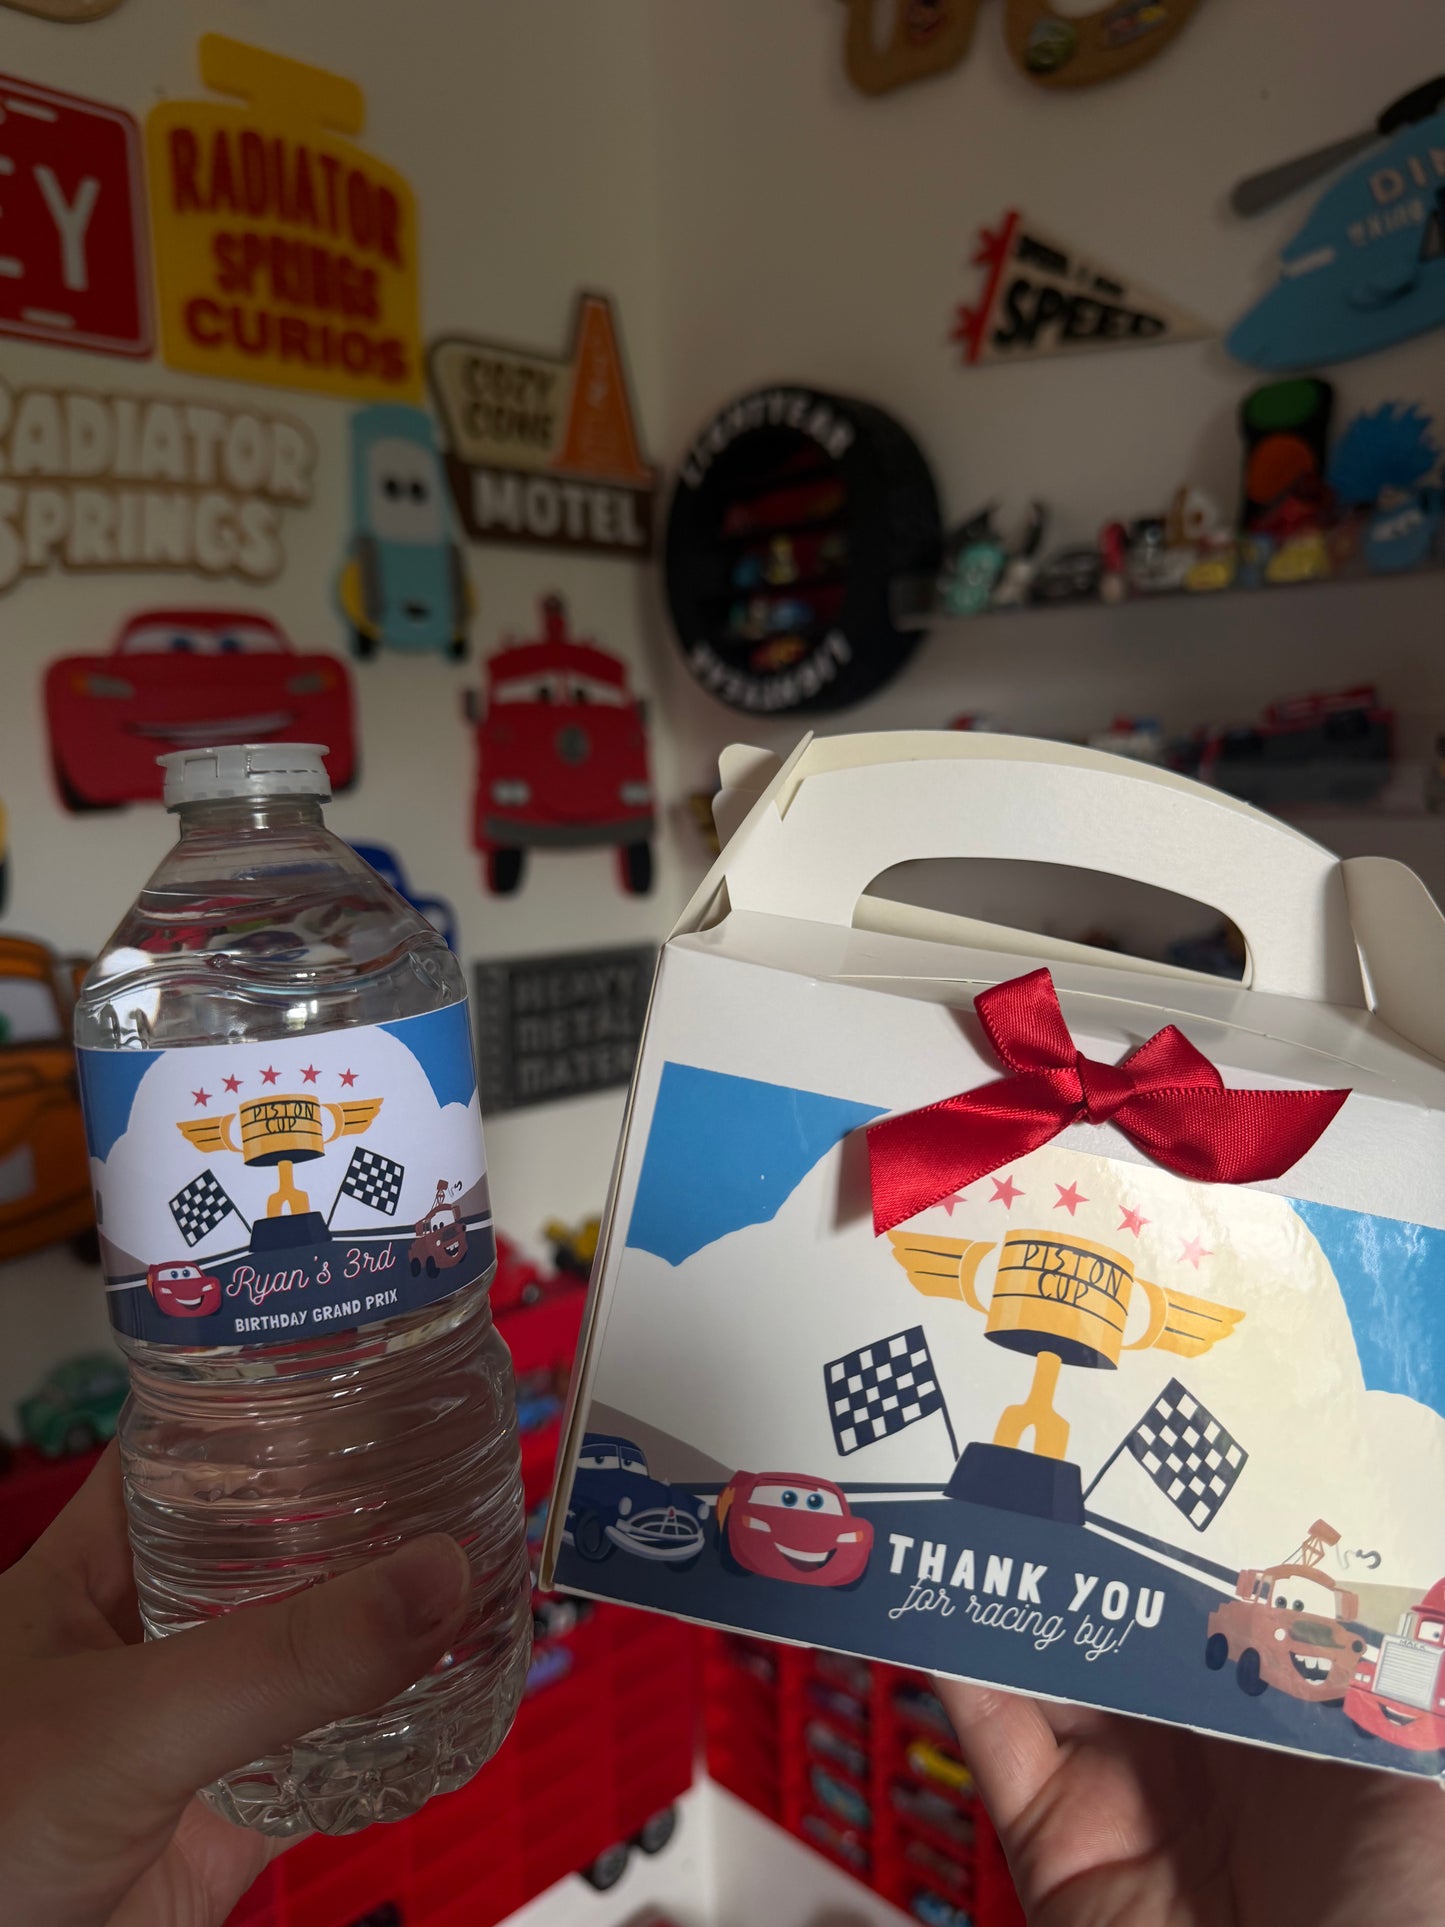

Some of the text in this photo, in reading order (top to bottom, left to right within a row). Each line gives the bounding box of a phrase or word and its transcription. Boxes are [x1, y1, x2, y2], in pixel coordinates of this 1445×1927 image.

[169, 128, 403, 268] RADIATOR
[212, 231, 380, 322] SPRINGS
[184, 297, 409, 384] CURIOS
[471, 470, 646, 545] MOTEL
[253, 1102, 314, 1121] PISTON
[265, 1117, 297, 1134] CUP
[343, 1241, 397, 1279] 3rd
[1022, 1242, 1125, 1299] PISTON
[1037, 1271, 1089, 1306] CUP
[235, 1288, 399, 1333] BIRTHDAY GRAND PRIX
[888, 1533, 1166, 1629] THANK YOU
[888, 1574, 1136, 1662] for racing by!
